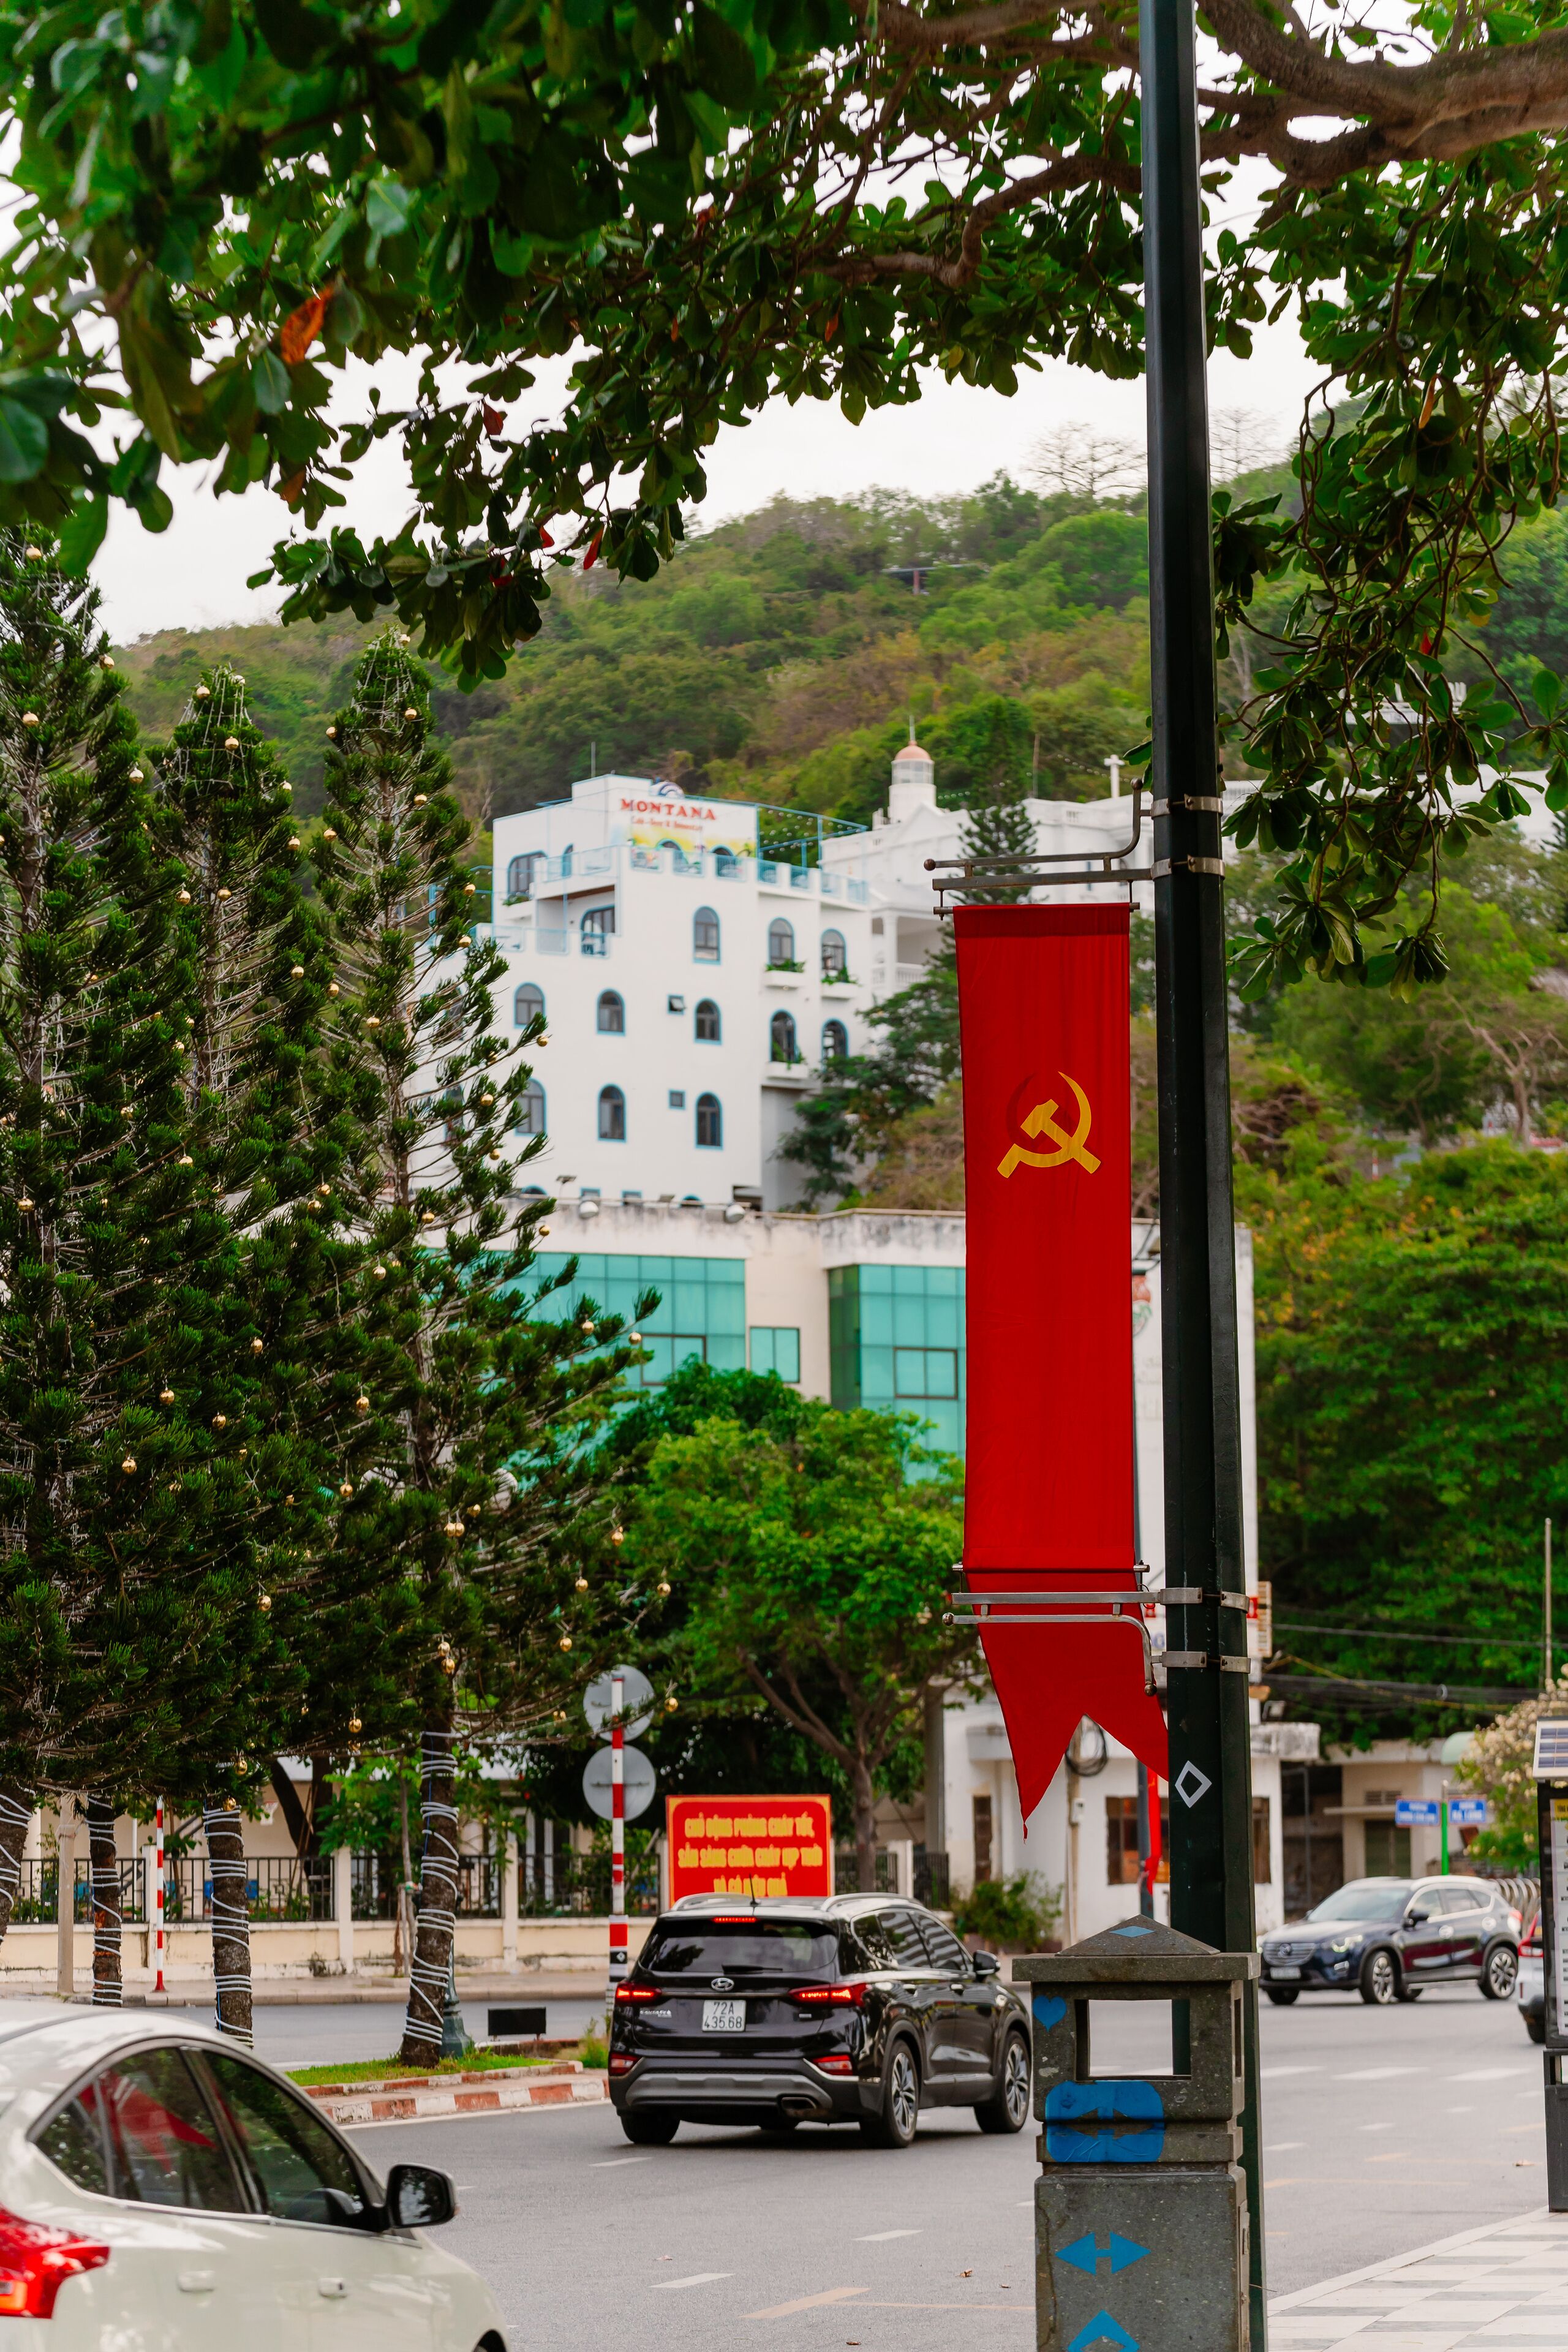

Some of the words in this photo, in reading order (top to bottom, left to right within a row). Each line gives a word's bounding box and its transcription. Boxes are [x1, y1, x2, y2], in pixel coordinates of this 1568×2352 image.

[620, 798, 716, 821] MONTANA
[713, 2002, 734, 2015] 72A
[704, 2016, 742, 2029] 435.68
